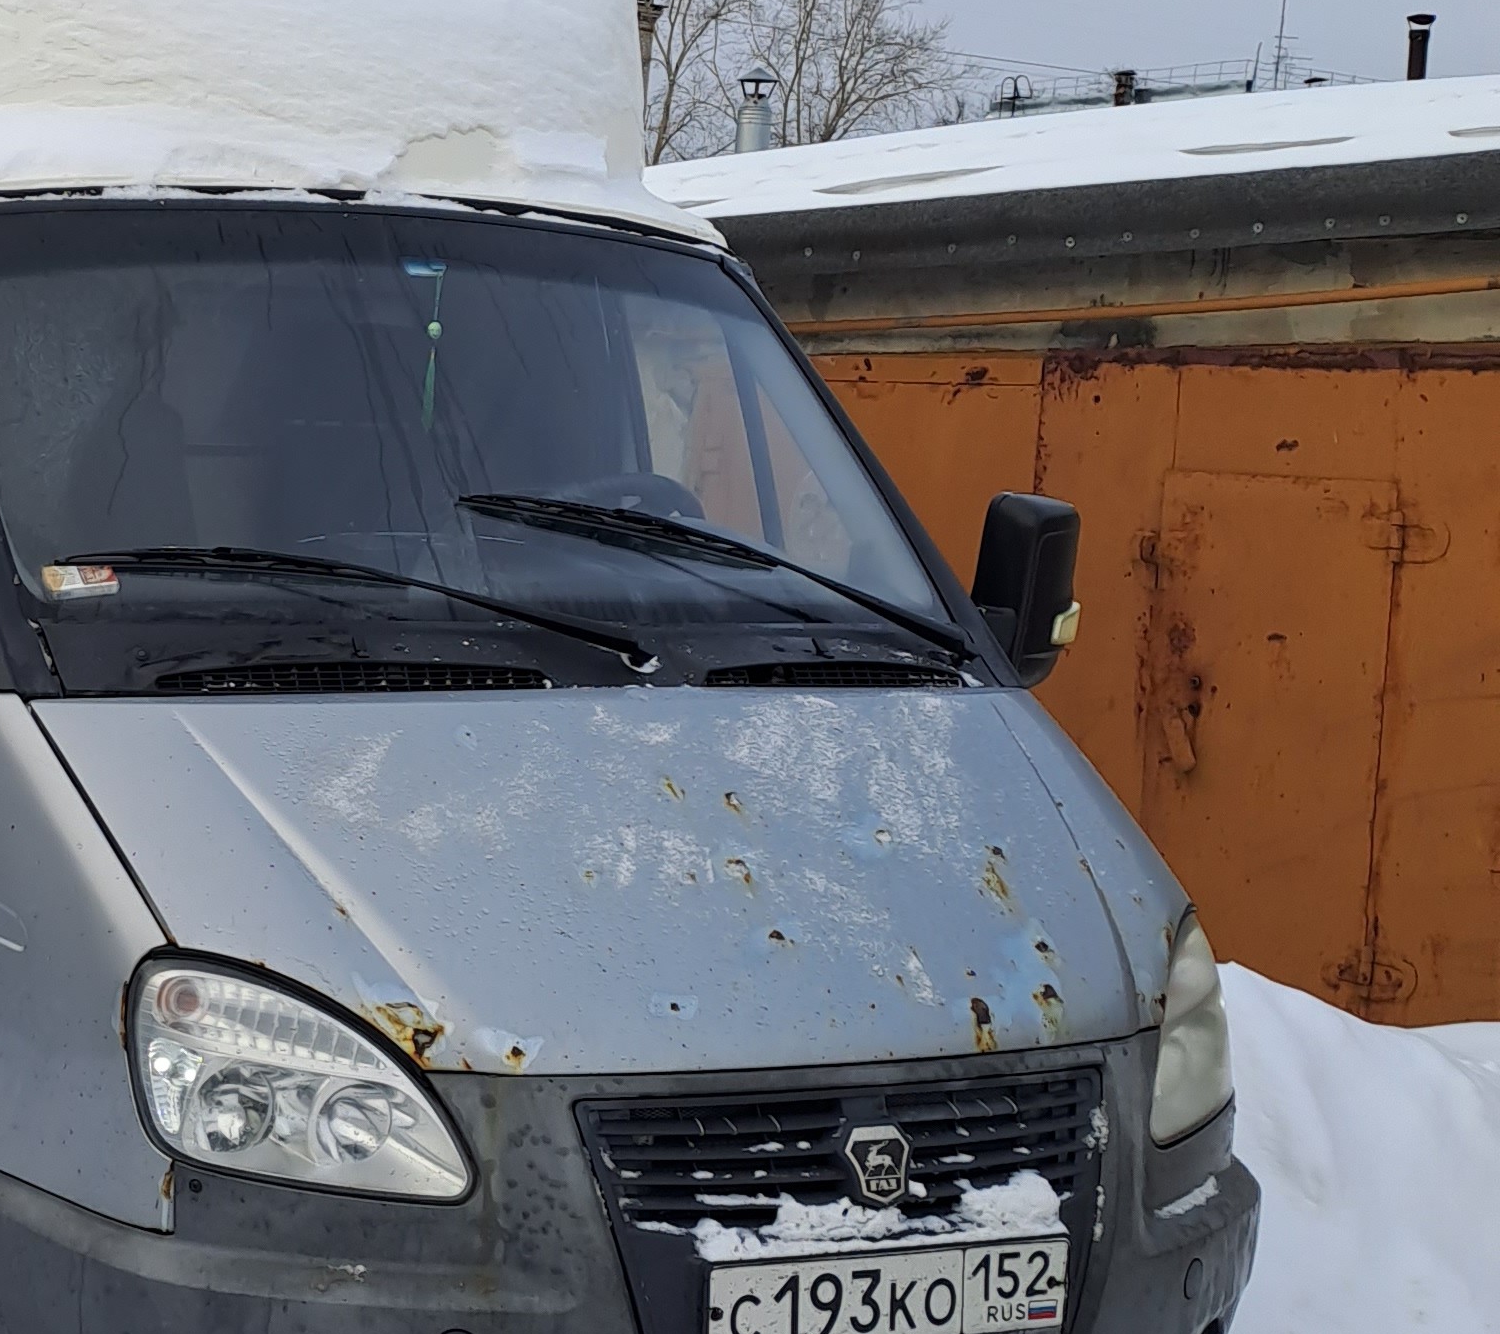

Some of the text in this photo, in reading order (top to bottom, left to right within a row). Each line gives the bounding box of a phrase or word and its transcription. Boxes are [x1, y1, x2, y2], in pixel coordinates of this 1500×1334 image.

[869, 1178, 898, 1192] ГАЗ
[971, 1250, 1051, 1302] 152
[986, 1304, 1027, 1324] RUS
